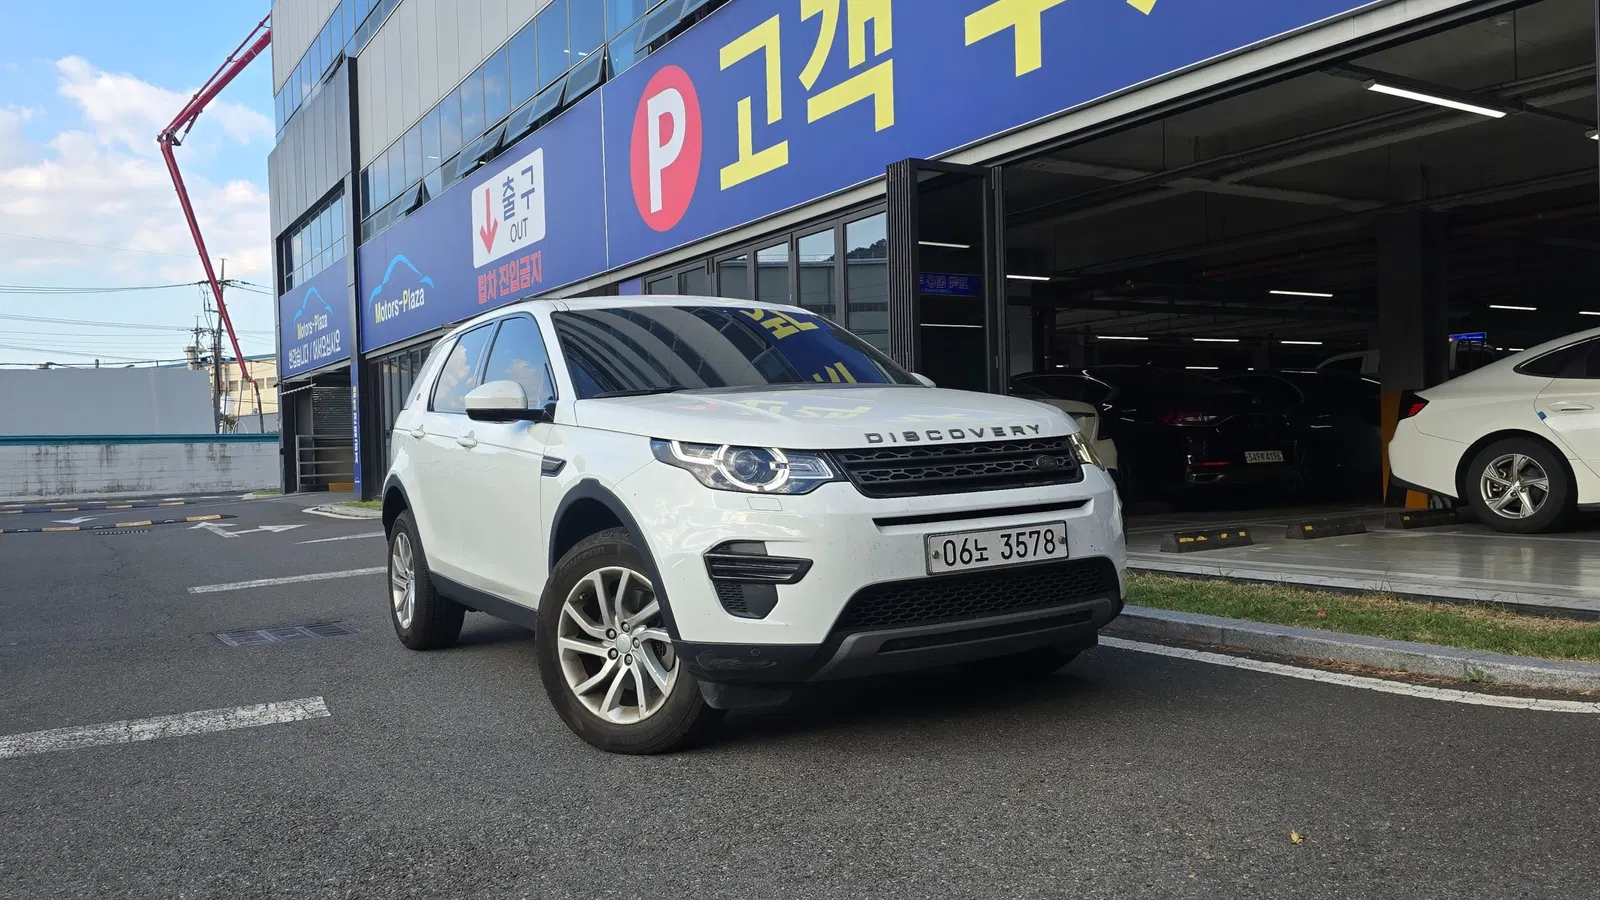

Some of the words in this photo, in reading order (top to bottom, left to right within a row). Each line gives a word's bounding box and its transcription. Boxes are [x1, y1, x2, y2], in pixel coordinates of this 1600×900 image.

[720, 0, 895, 190] 고객
[647, 88, 686, 213] P
[502, 165, 535, 221] 출구
[510, 217, 529, 243] OUT
[499, 250, 543, 297] 진입금지
[375, 287, 425, 324] Motors-Plaza
[297, 313, 328, 340] Motors-Plaza
[313, 329, 341, 361] 어서오십시오
[865, 424, 1040, 444] DISCOVERY
[943, 537, 989, 567] 06노
[1000, 528, 1056, 560] 3578
